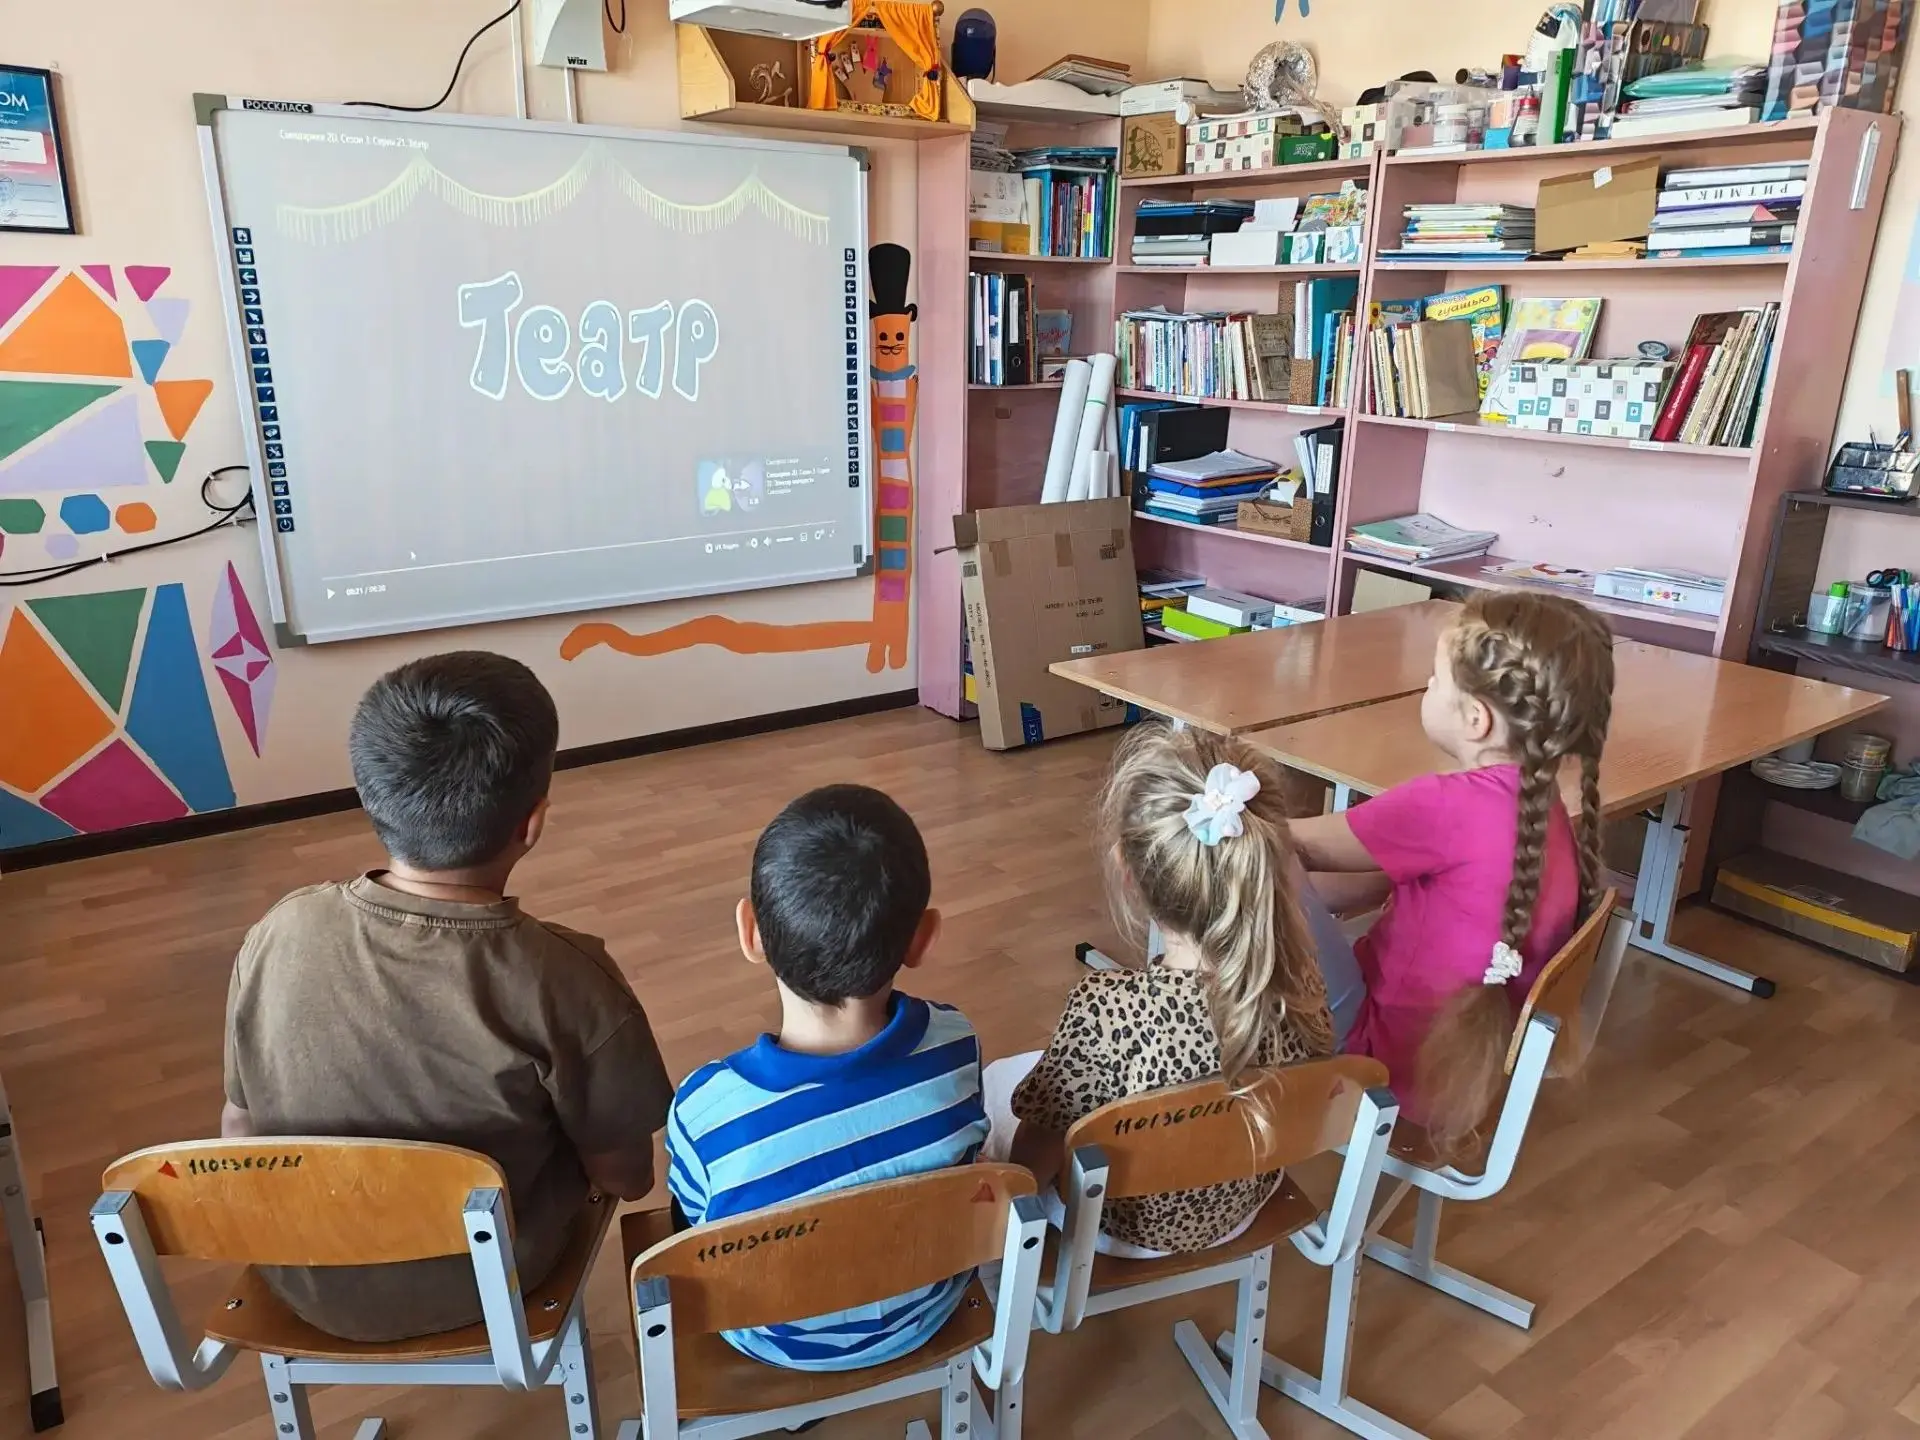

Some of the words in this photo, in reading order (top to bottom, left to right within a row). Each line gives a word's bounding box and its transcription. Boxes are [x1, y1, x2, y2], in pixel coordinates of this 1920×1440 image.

[245, 100, 310, 114] РОССКЛАСС
[1684, 183, 1789, 201] РИТМИКА
[1437, 295, 1490, 317] гуашью
[457, 270, 720, 402] Театр
